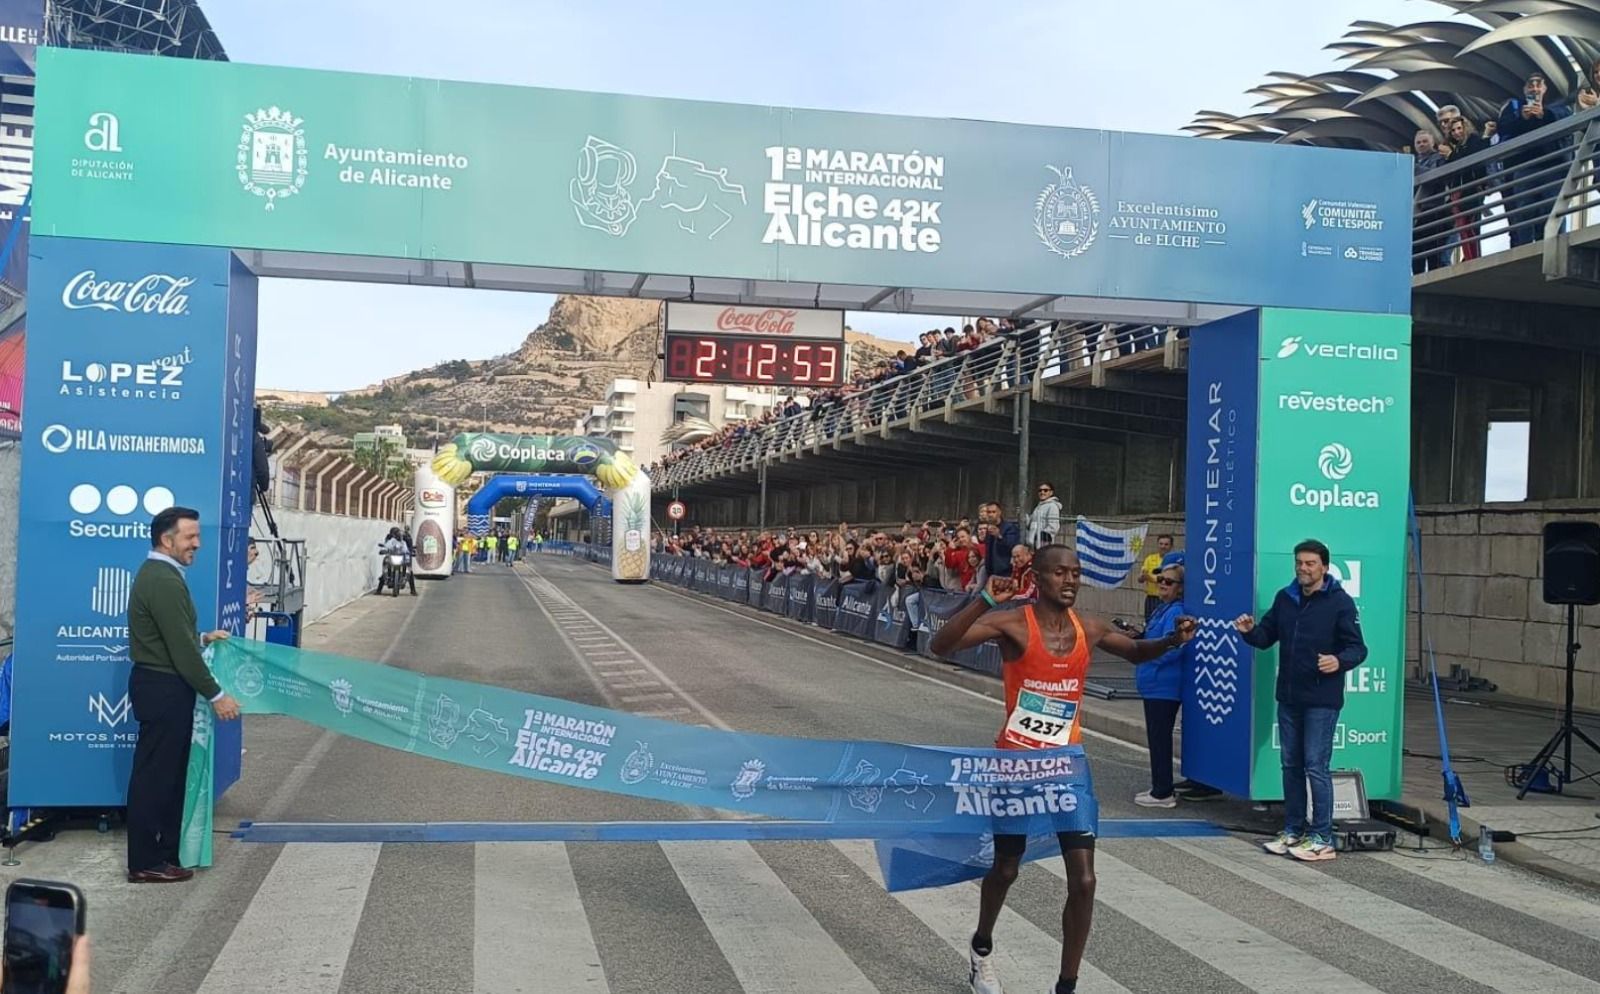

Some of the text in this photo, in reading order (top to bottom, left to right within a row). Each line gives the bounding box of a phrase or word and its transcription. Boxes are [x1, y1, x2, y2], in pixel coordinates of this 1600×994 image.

[71, 159, 134, 171] DIPUTACIÓN
[324, 143, 469, 170] Ayuntamiento
[763, 145, 944, 181] 1ª MARATÓN
[71, 169, 134, 180] DE ALICANTE
[339, 166, 452, 190] de Alicante
[804, 169, 944, 191] INTERNACIONAL
[763, 183, 942, 224] Elche 42K
[1117, 201, 1219, 218] Excelentísimo
[1318, 207, 1377, 220] COMUNITAT
[761, 211, 942, 253] Alicante
[1108, 216, 1226, 234] AYUNTAMIENTO
[1322, 217, 1384, 230] DE L'ESPORT
[1134, 233, 1201, 248] de ELCHE
[695, 340, 837, 382] 2:12:53
[1303, 343, 1398, 361] vectalia
[59, 383, 181, 400] Asistencia
[75, 429, 206, 455] HLA VISTAHERMOSA
[499, 445, 565, 466] Coplaca
[1203, 381, 1223, 606] MONTEMAR
[1289, 483, 1380, 512] Coplaca
[1224, 521, 1234, 576] CLUB
[540, 725, 611, 747] INTERNACIONAL
[542, 712, 617, 739] MARATÓN
[1018, 716, 1065, 737] 4237
[49, 733, 139, 741] MOTOS ME
[513, 729, 607, 767] Elche 42K
[1347, 729, 1388, 746] Sport
[509, 747, 599, 780] Alicante
[969, 766, 1073, 783] INTERNACIONAL
[955, 786, 1078, 817] Alicante
